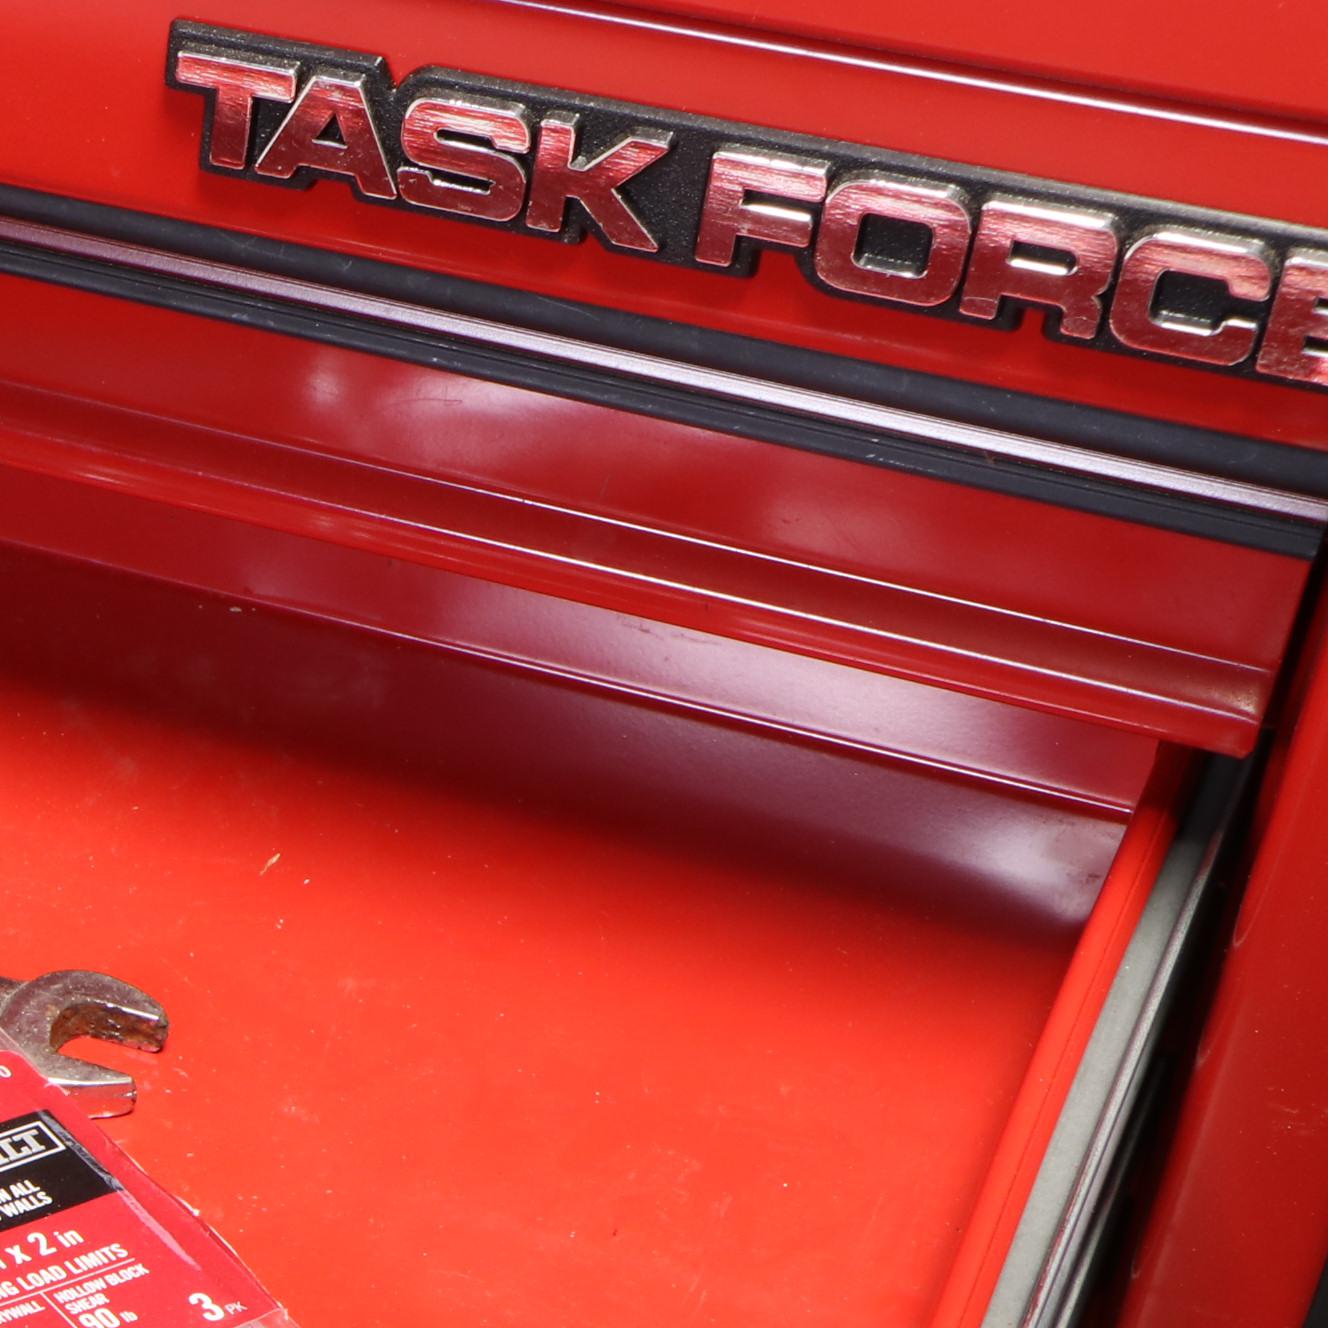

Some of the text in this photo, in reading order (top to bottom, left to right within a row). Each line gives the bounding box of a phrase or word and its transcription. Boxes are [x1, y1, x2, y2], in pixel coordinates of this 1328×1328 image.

[176, 45, 672, 253] TASK
[9, 1179, 41, 1197] ALL
[26, 1232, 57, 1256] 2
[53, 1229, 84, 1248] in
[16, 1264, 68, 1291] LOAD
[63, 1243, 129, 1275] LIMITS
[53, 1263, 150, 1304] HOLLOW BLOCK
[64, 1292, 110, 1315] SHEAR
[119, 1310, 139, 1324] lb
[188, 1292, 248, 1322] 3 PK
